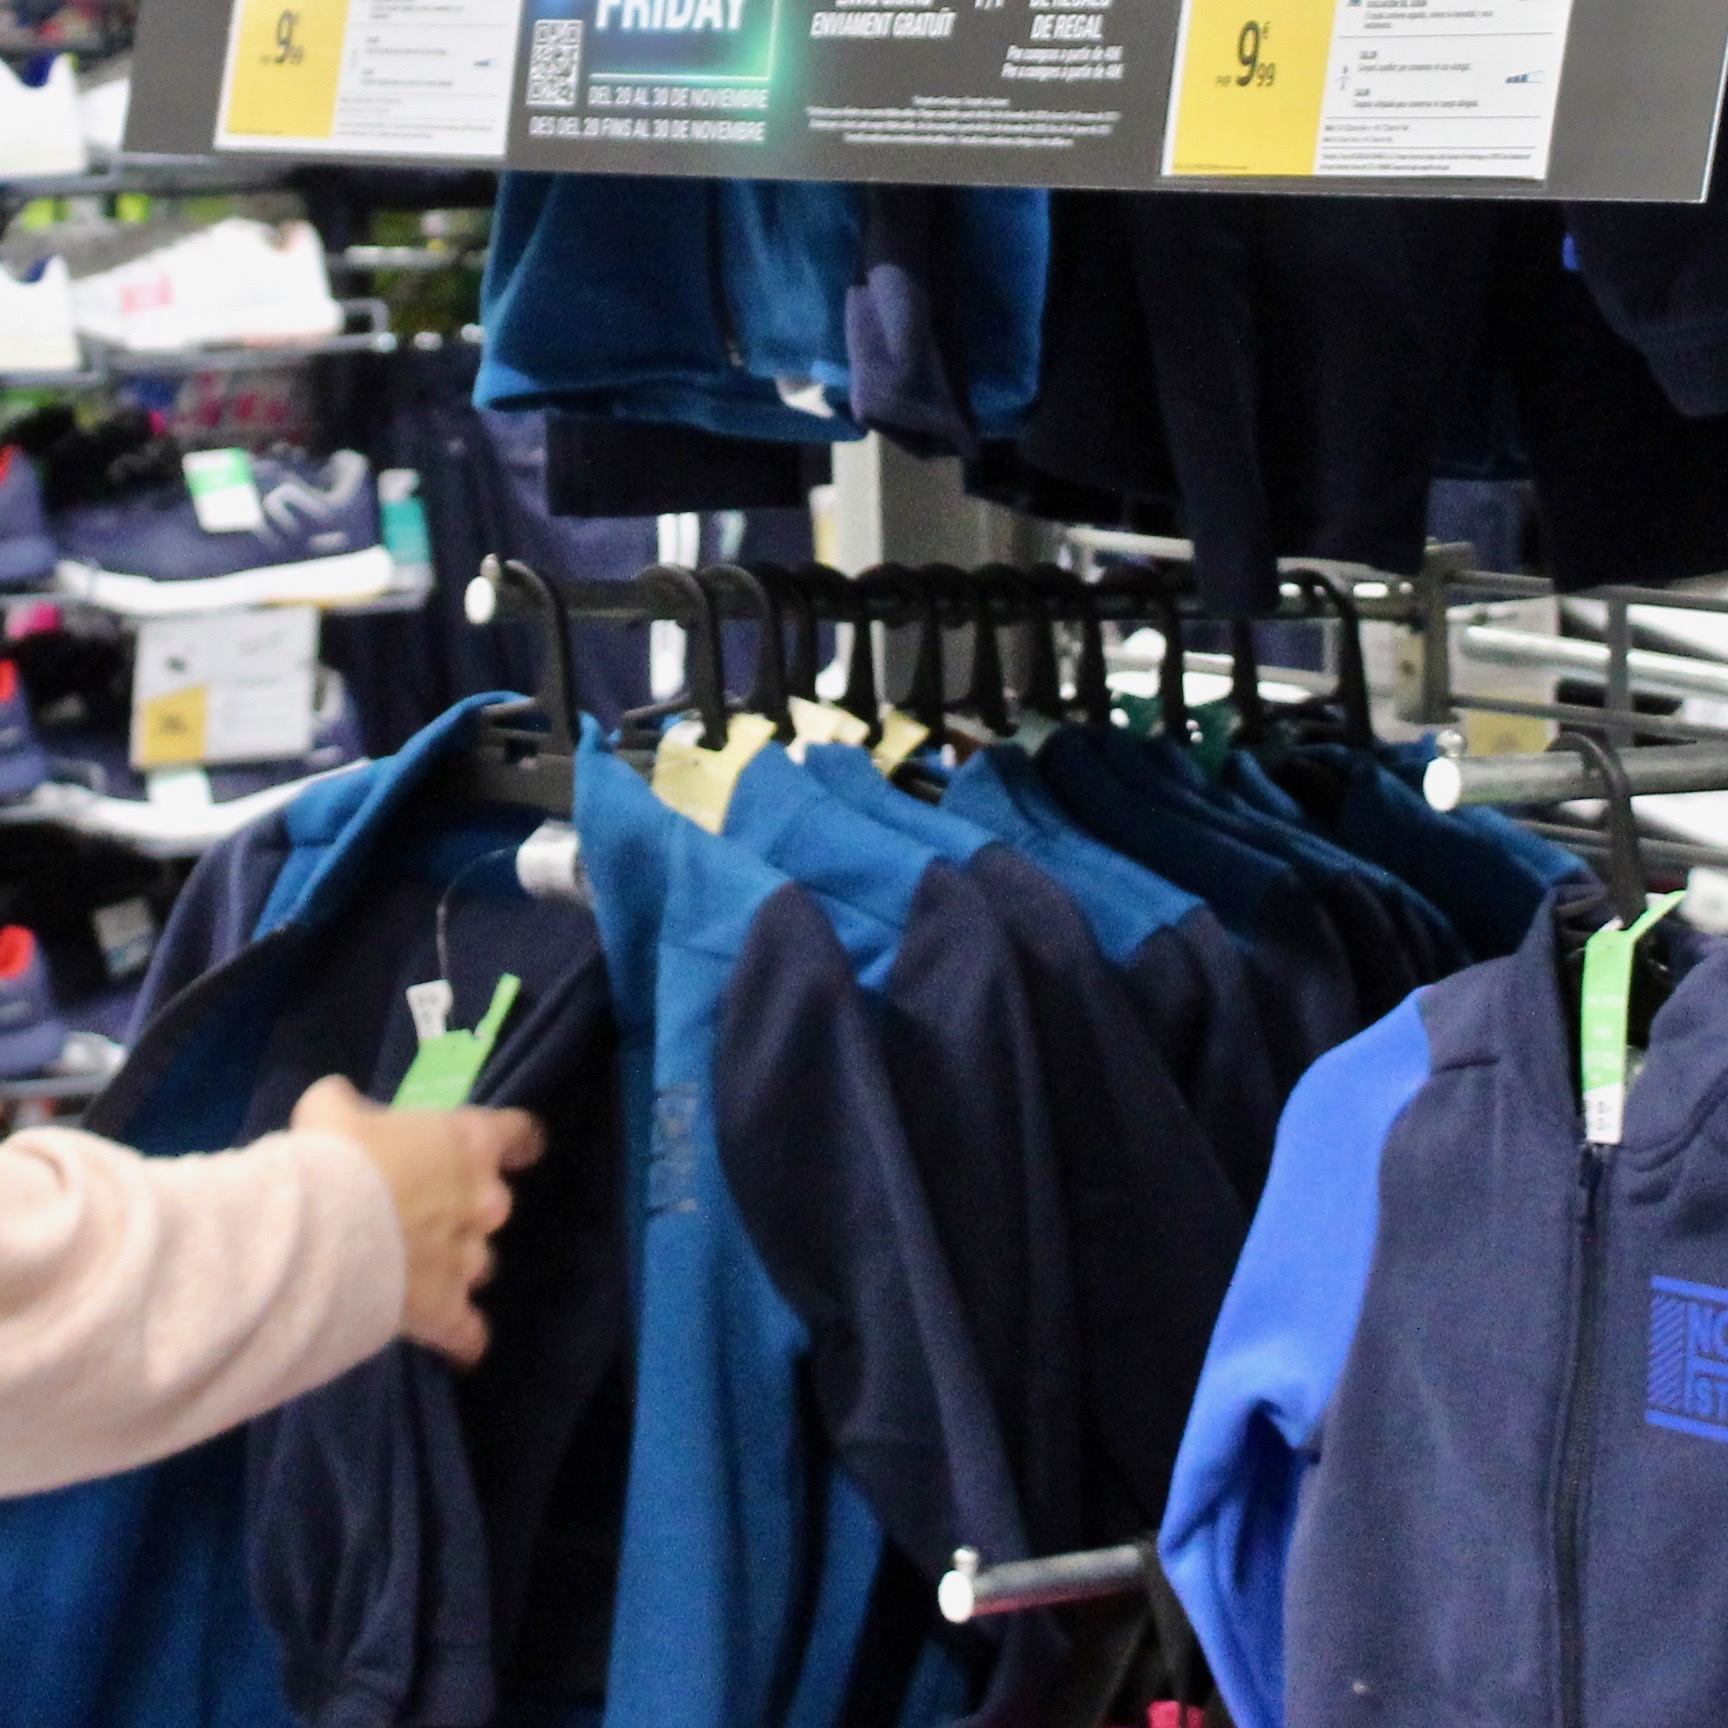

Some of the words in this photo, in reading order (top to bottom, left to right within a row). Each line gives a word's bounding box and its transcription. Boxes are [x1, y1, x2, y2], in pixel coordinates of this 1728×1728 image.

[1030, 14, 1054, 41] DE
[1053, 14, 1104, 41] REGAL
[1236, 19, 1262, 87] 9
[1254, 61, 1278, 88] 99
[587, 85, 612, 107] DEL
[631, 86, 650, 107] AL
[670, 87, 689, 108] DE
